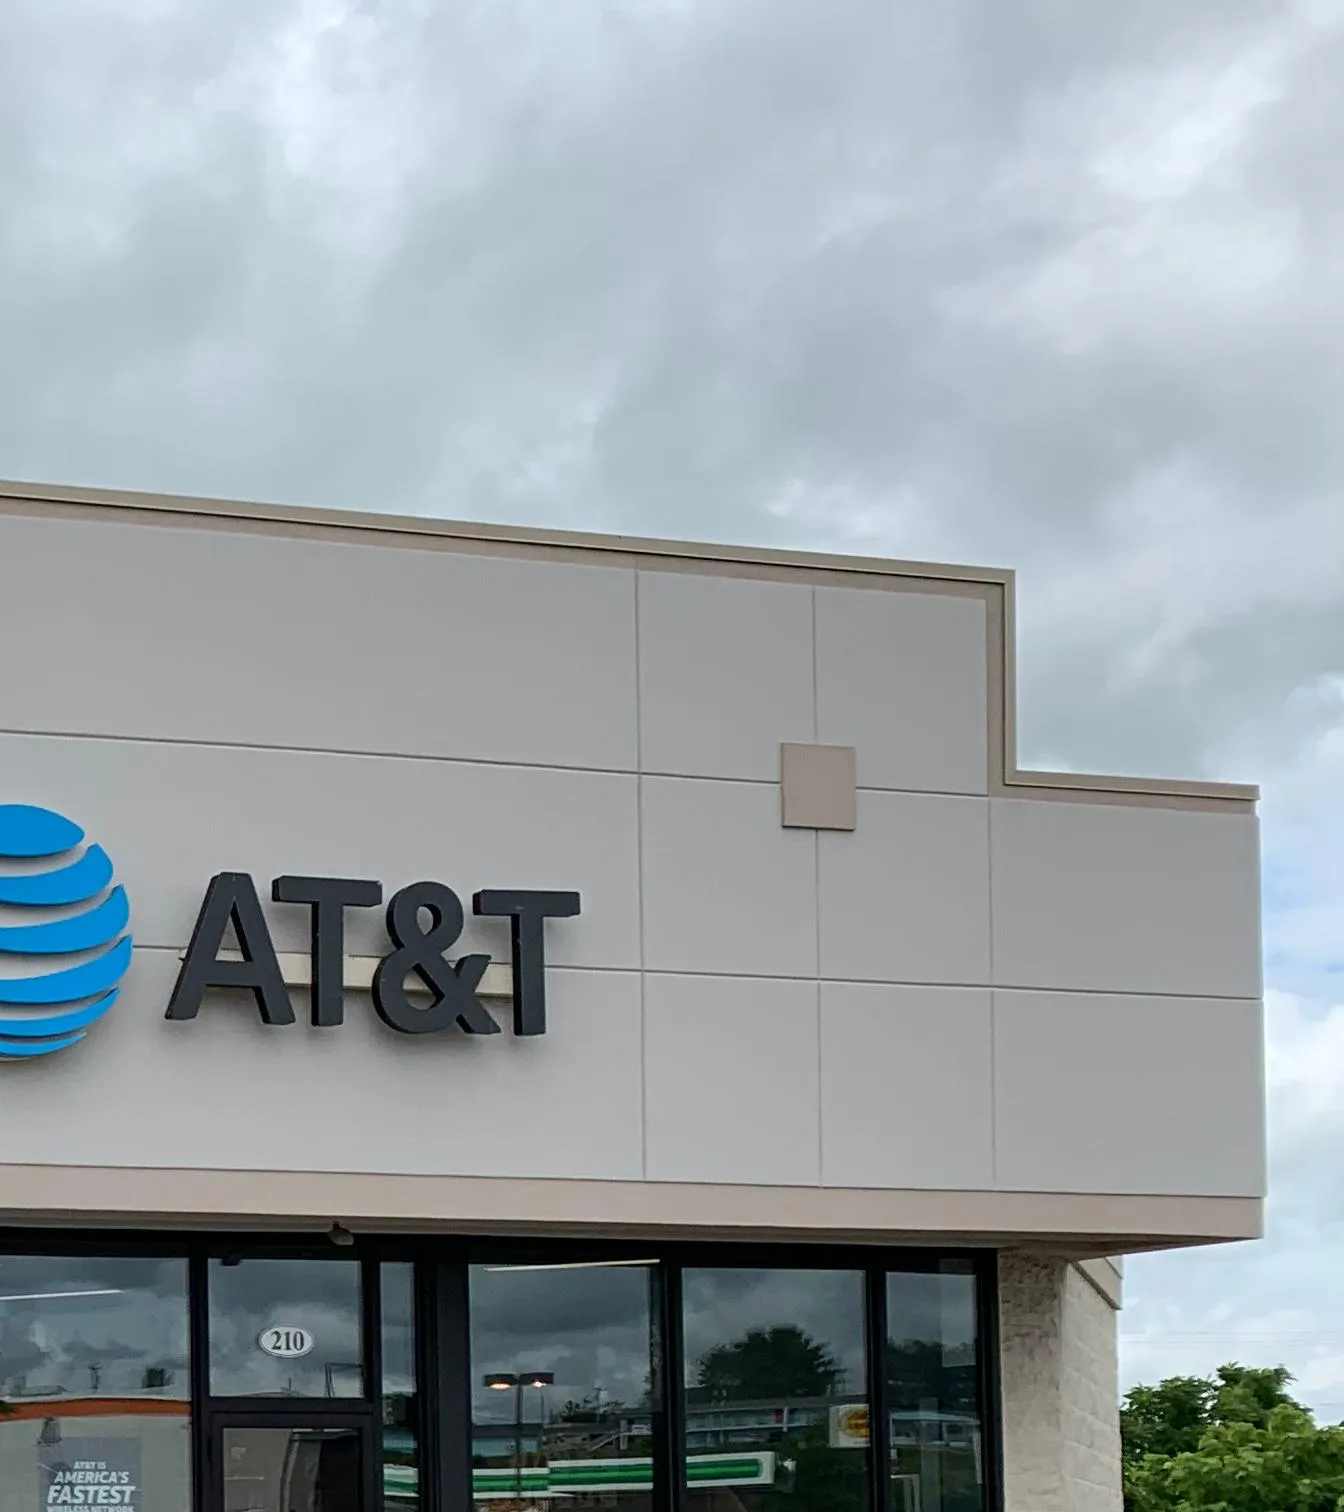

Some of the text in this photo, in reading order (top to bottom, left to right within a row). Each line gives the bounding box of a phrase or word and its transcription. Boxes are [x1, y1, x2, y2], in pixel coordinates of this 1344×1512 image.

[164, 871, 581, 1036] AT&T
[271, 1330, 304, 1351] 210
[74, 1461, 95, 1470] AT&T
[54, 1471, 130, 1484] AMERICA'S
[47, 1485, 136, 1504] FASTEST
